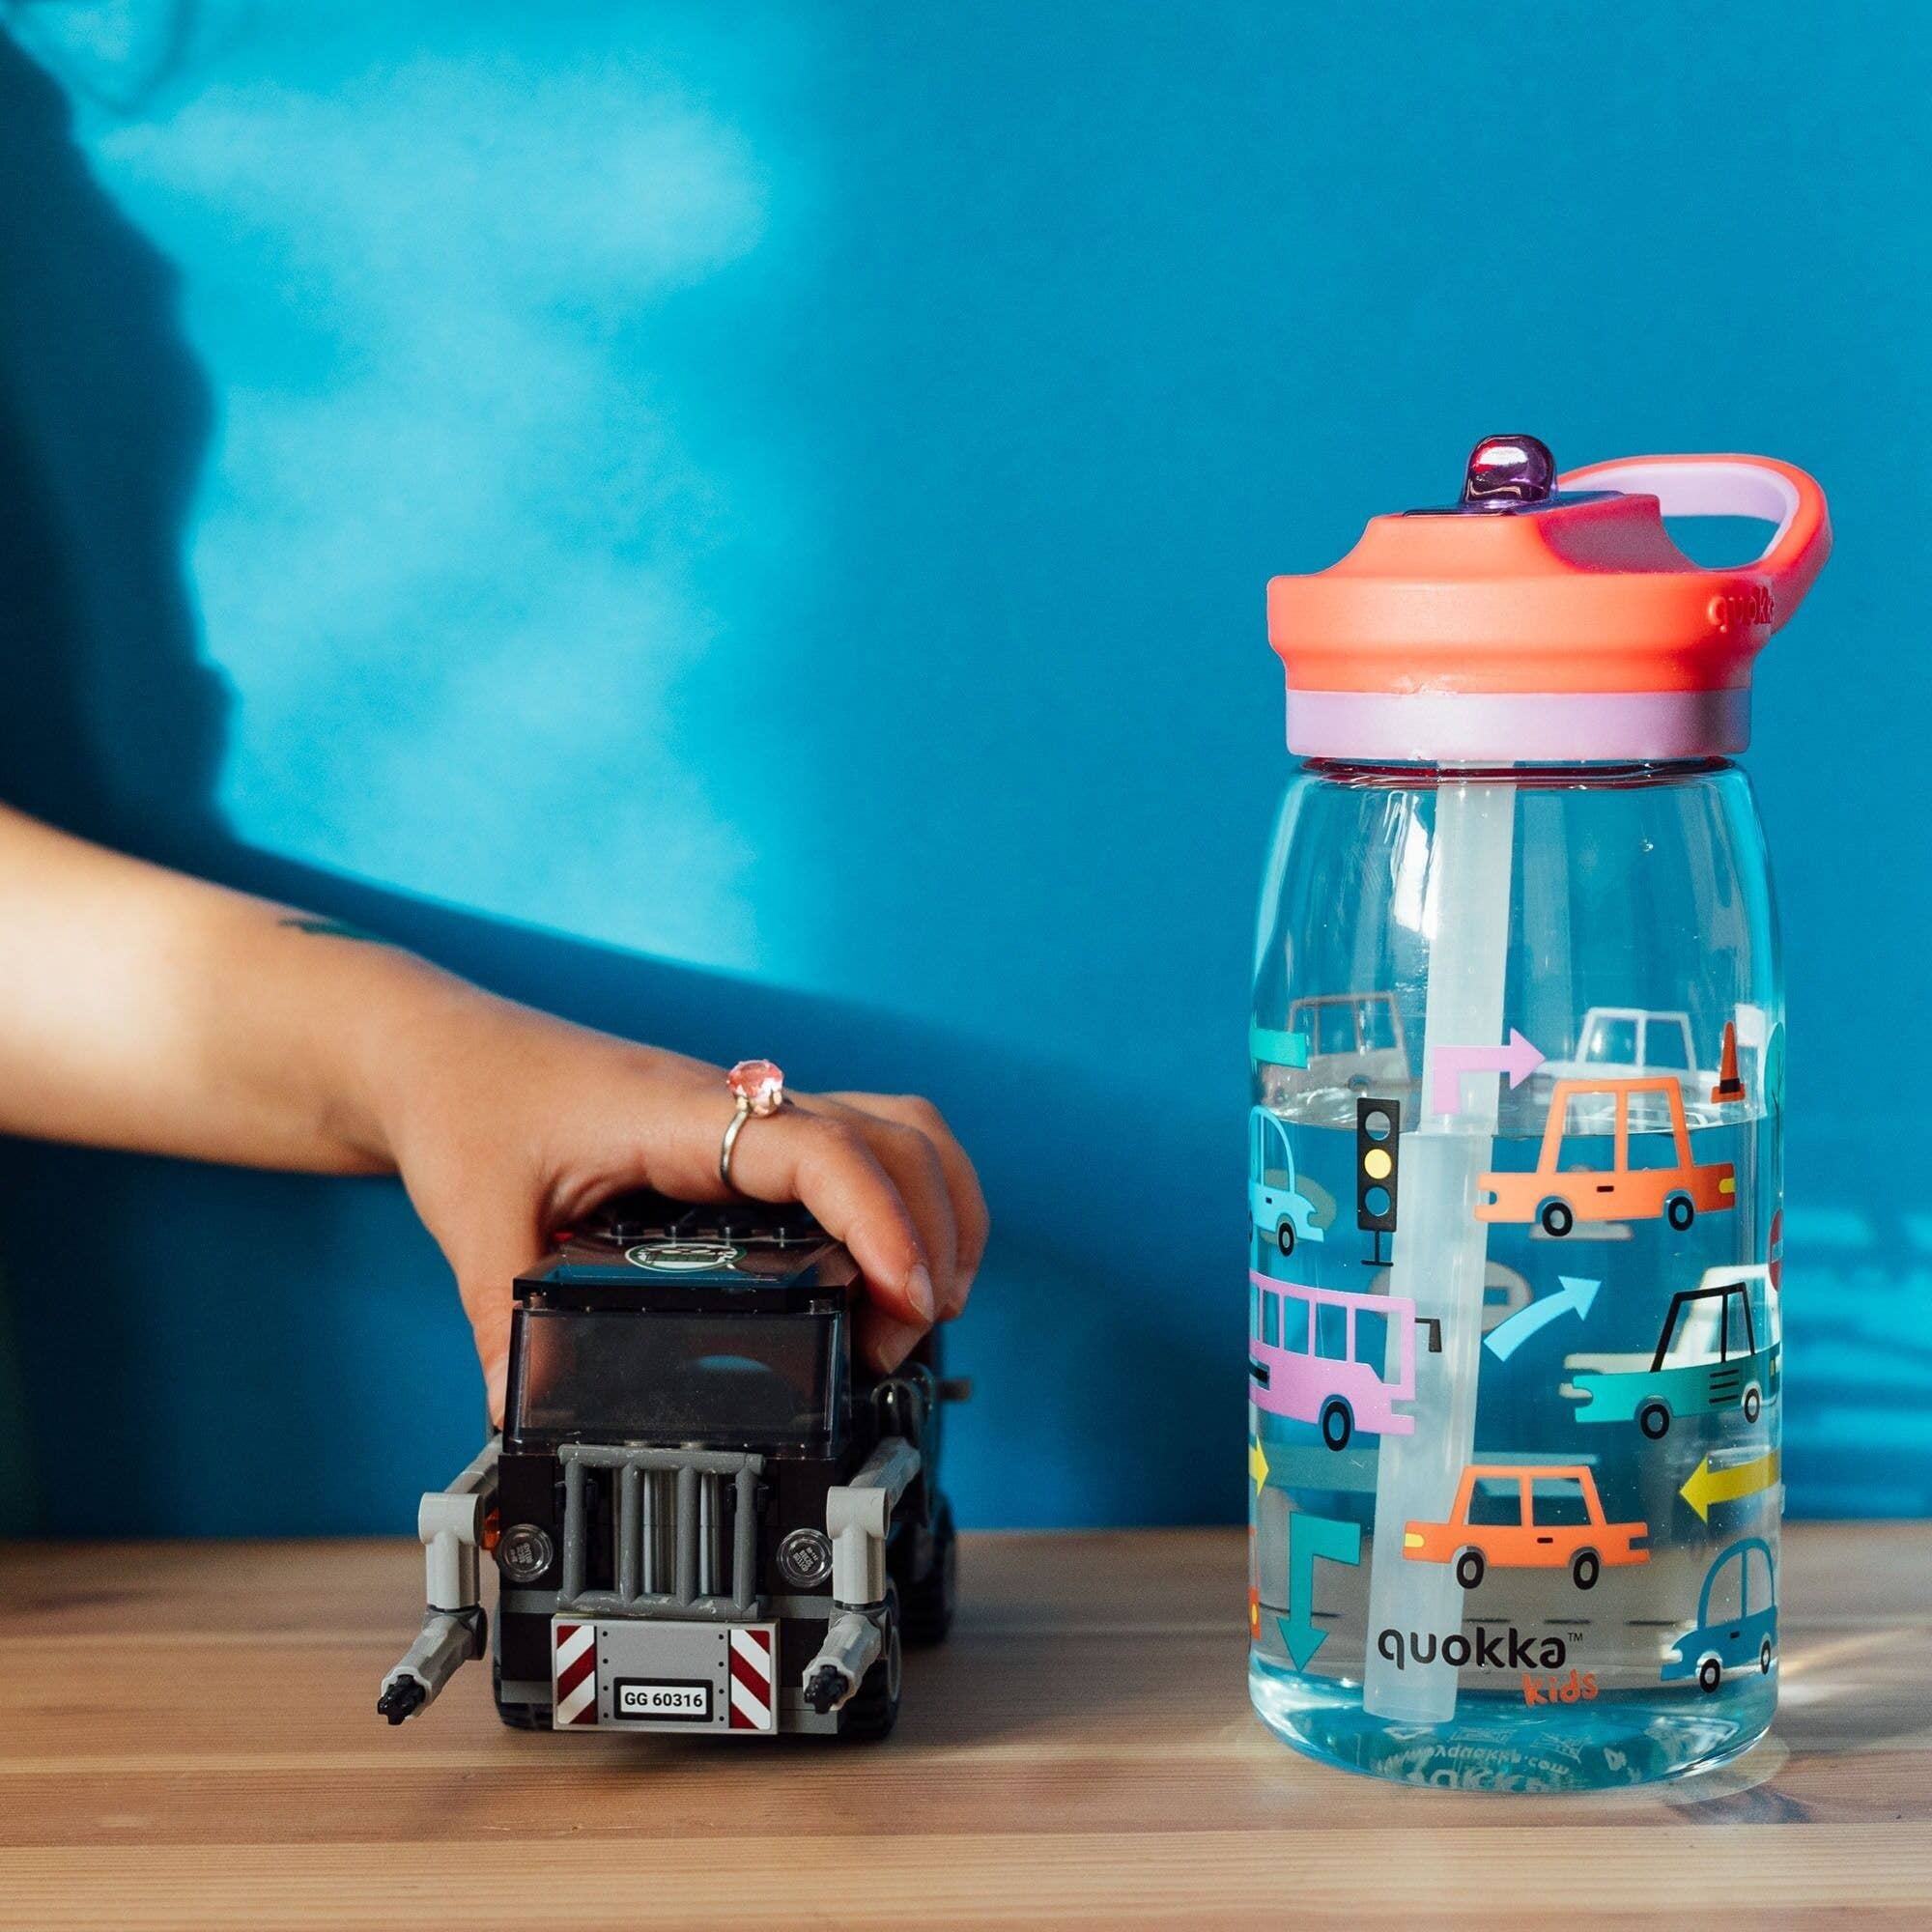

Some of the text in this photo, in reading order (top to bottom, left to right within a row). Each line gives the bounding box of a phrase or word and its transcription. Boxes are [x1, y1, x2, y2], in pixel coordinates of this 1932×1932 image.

[1378, 1627, 1566, 1670] quokka
[624, 1691, 703, 1707] GG 60316
[1521, 1668, 1599, 1708] kids
